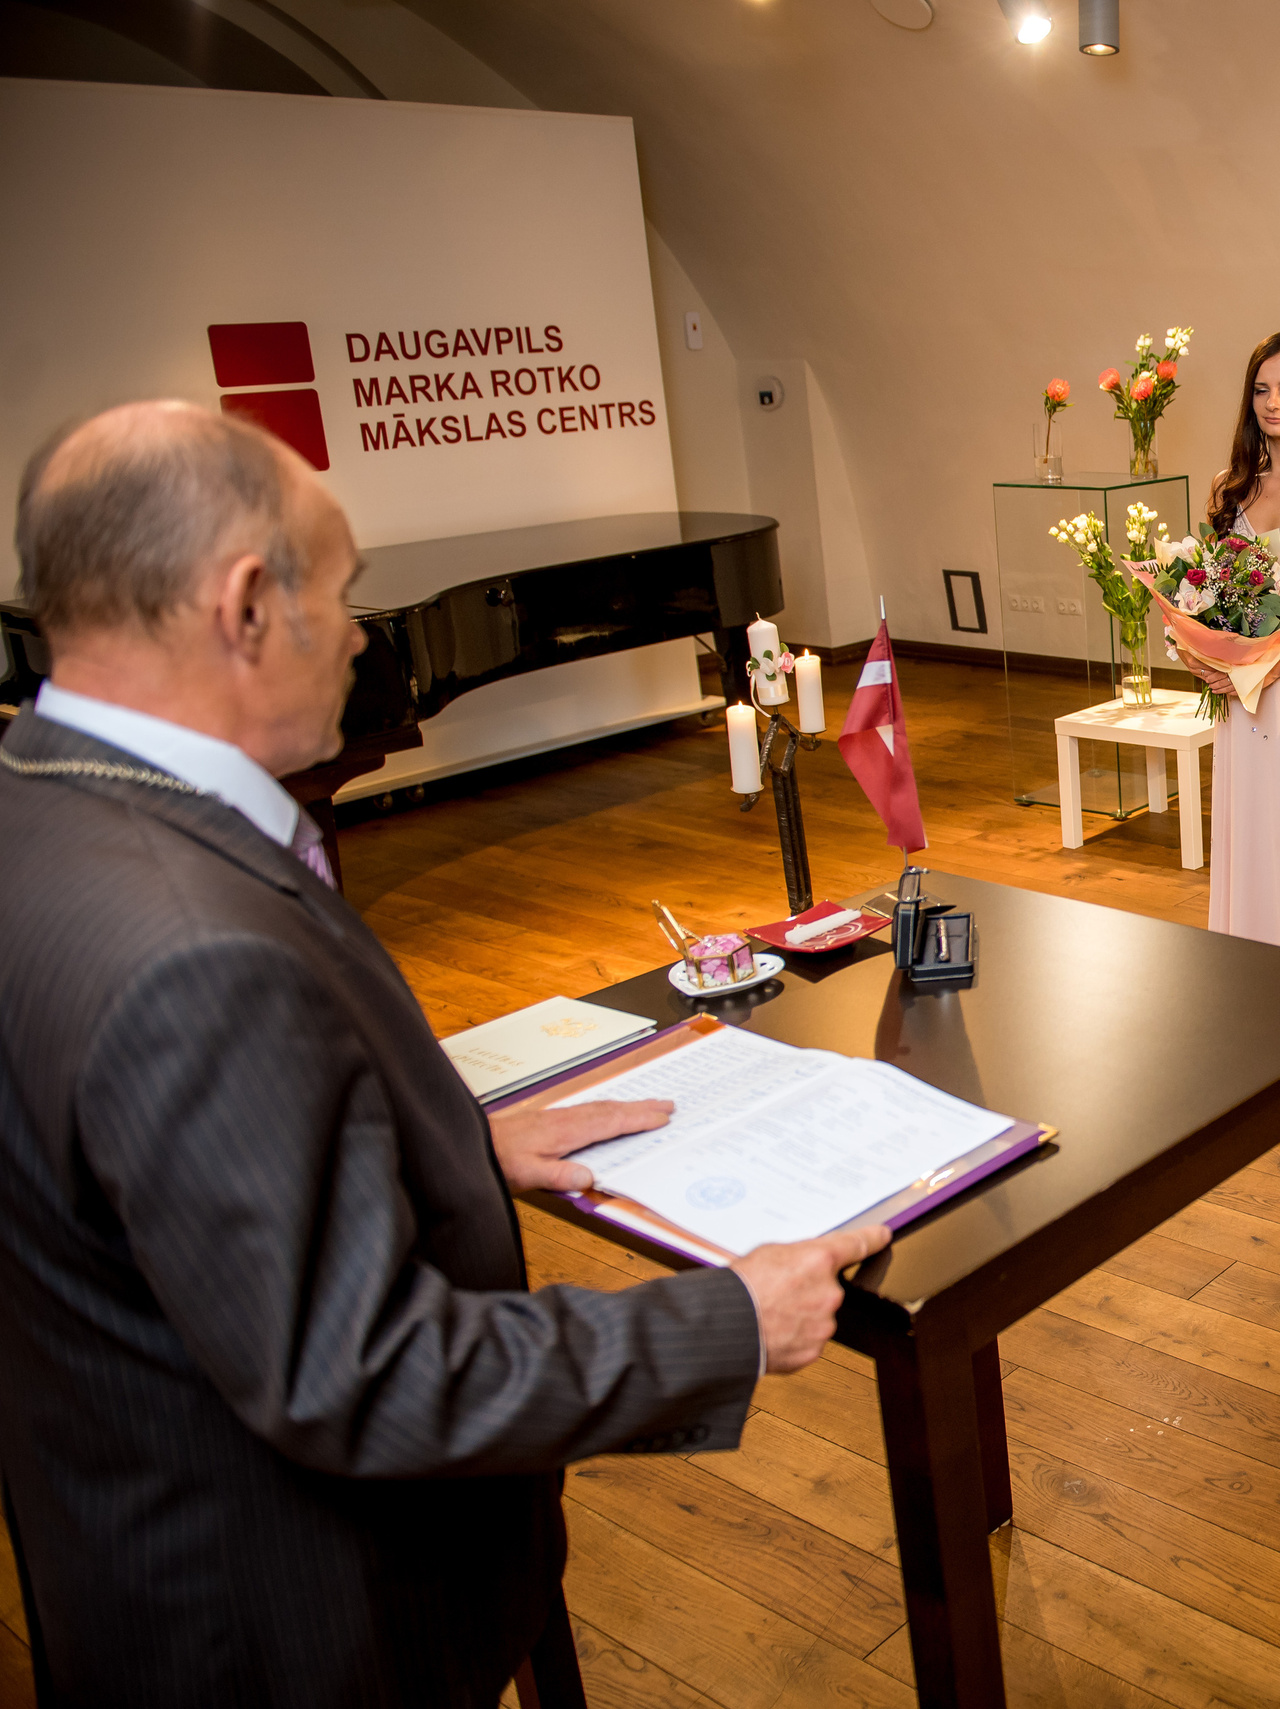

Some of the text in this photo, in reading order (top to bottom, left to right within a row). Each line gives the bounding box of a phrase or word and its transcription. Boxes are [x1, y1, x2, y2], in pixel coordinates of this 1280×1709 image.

[345, 325, 564, 363] DAUGAVPILS
[352, 364, 602, 408] MARKA ROTKO
[359, 399, 656, 452] MĀKSLAS CENTRS
